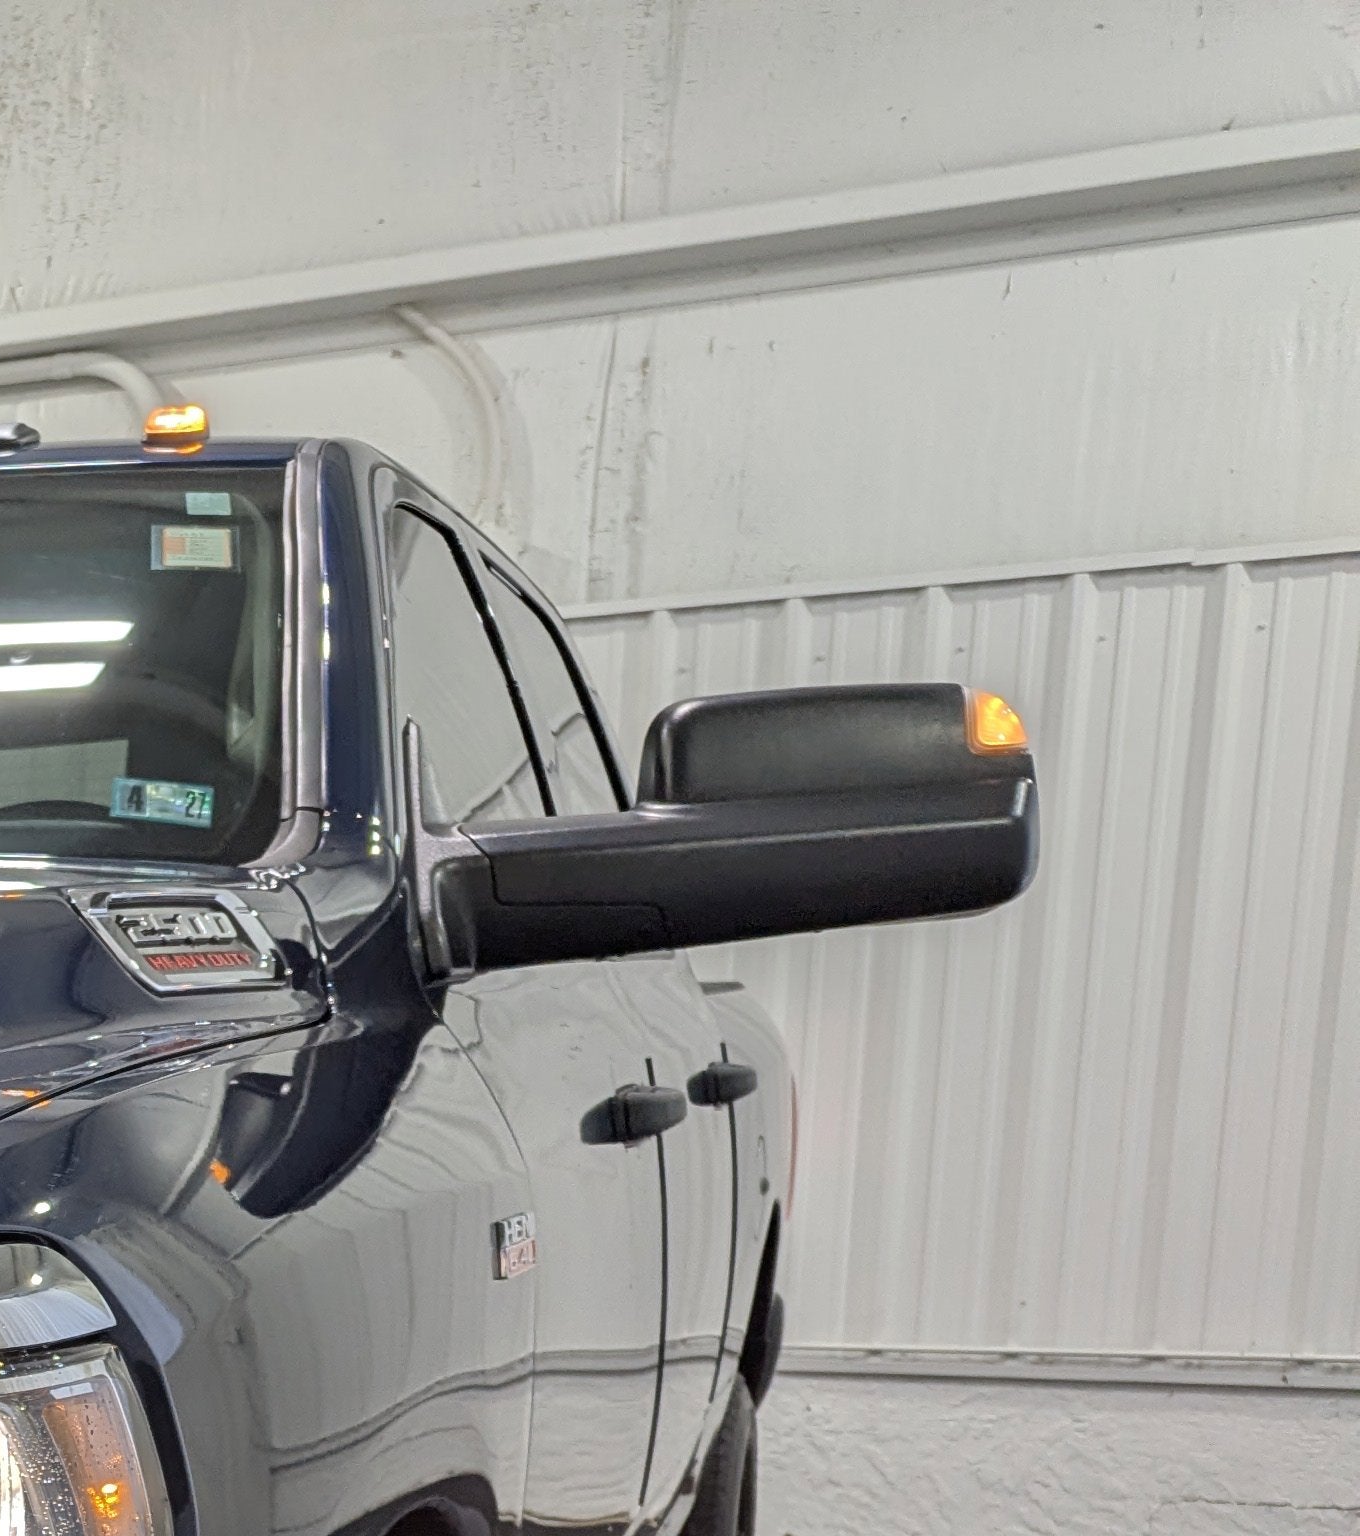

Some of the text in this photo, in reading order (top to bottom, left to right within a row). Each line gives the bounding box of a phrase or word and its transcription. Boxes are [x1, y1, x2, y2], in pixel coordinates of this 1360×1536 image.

[116, 911, 238, 948] 2500
[146, 951, 253, 971] HEAVY DUTY
